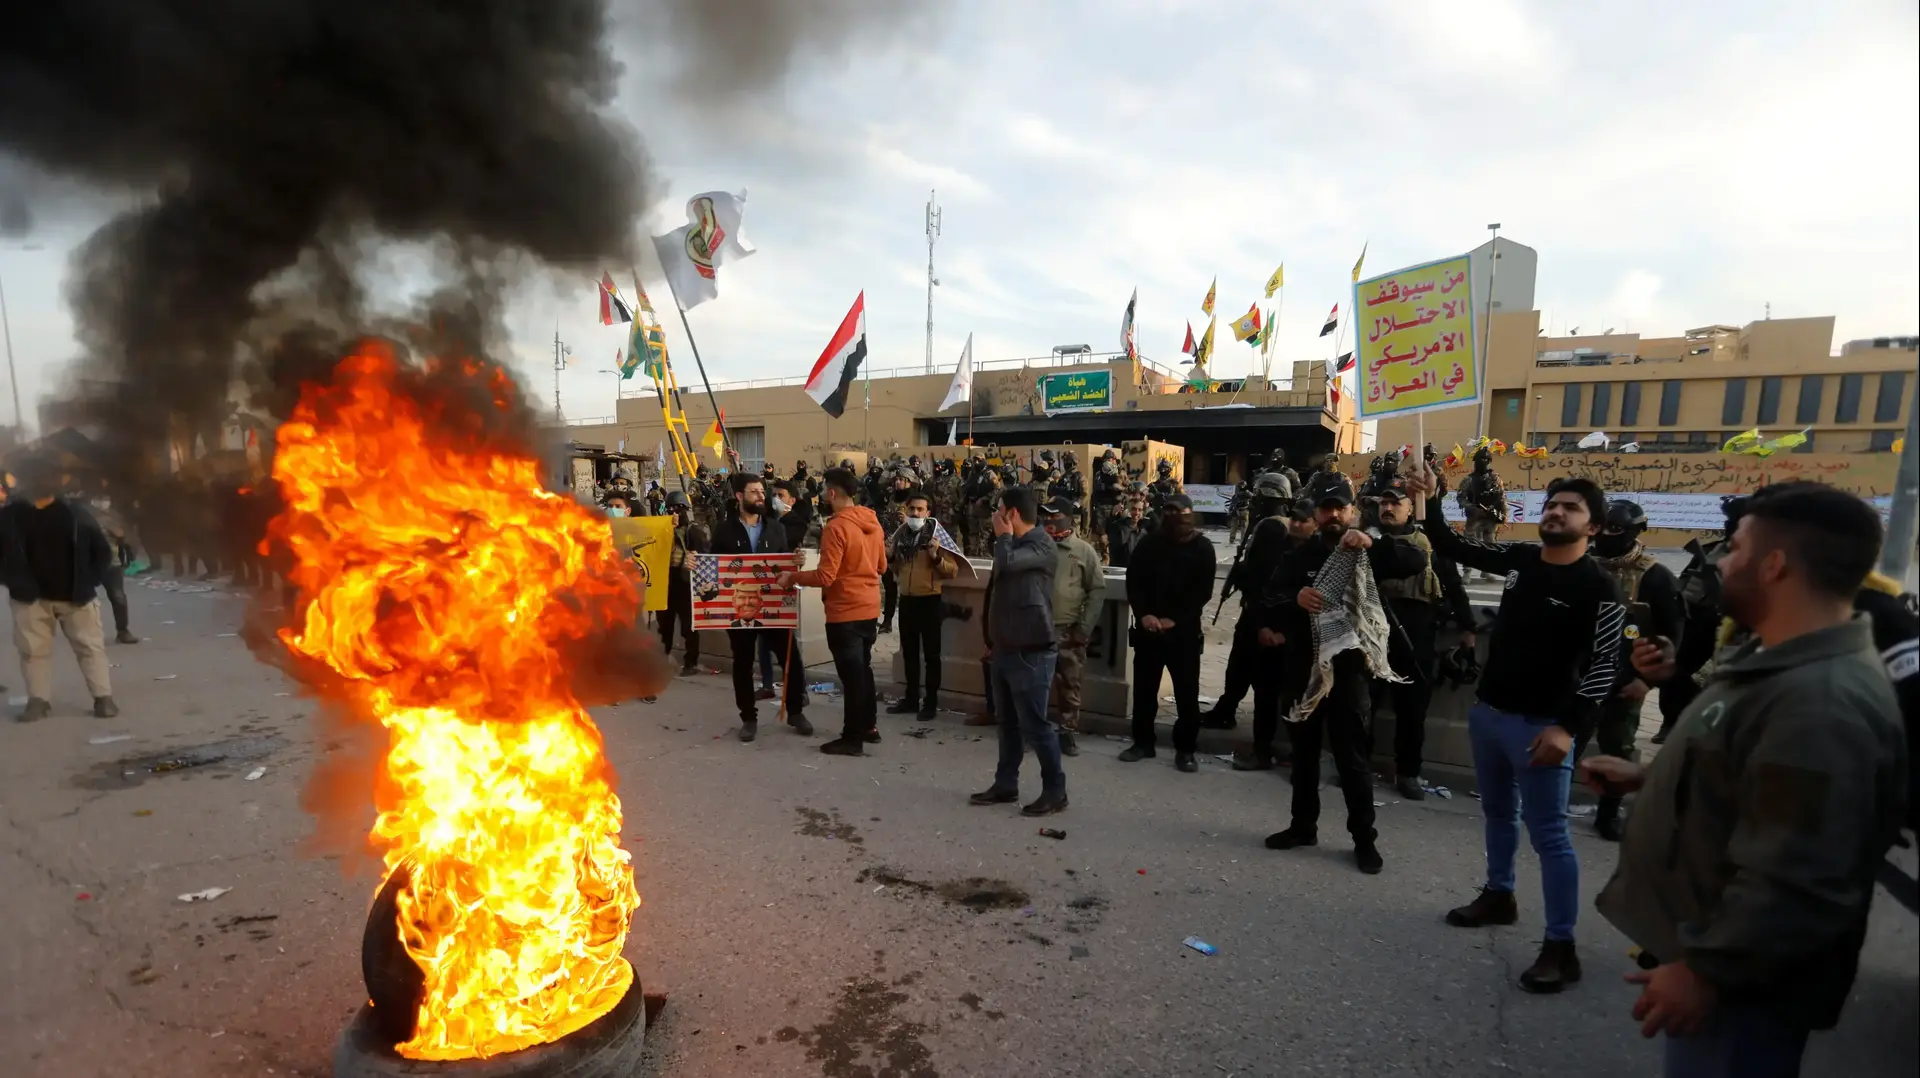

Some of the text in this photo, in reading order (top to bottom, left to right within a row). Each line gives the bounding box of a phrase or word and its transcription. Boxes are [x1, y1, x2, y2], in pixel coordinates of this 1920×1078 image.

[1366, 268, 1465, 307] من سيوقف
[1368, 298, 1465, 343] الاحتلال
[1082, 388, 1106, 399] الحشد
[1367, 363, 1464, 403] في العراق
[1049, 390, 1080, 405] الشعبي
[1620, 457, 1678, 471] الشهيد
